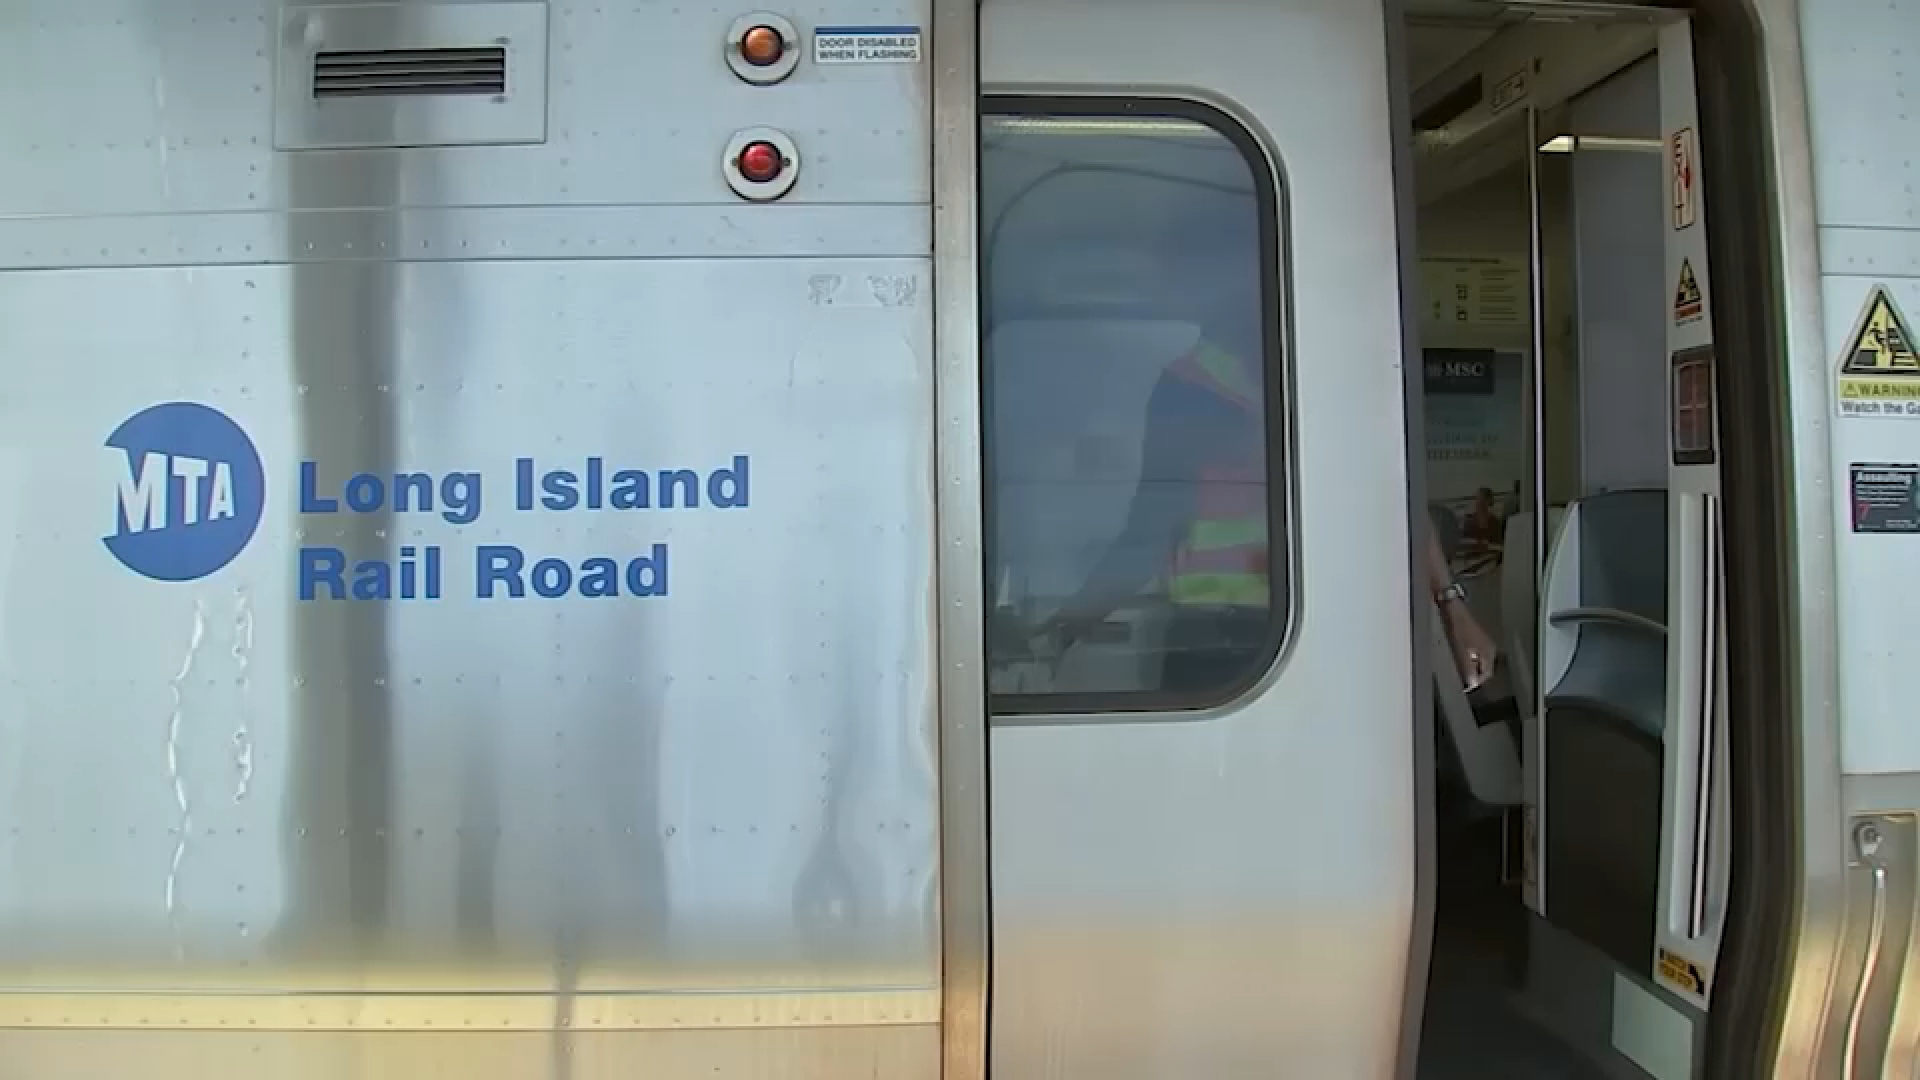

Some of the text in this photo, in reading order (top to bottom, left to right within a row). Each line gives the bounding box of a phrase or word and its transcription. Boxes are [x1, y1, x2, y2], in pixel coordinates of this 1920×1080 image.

[819, 37, 917, 48] DOOR DISABLED
[819, 49, 917, 60] WHEN FLASHING
[1445, 361, 1485, 377] MSC
[1841, 401, 1881, 413] Watch
[1883, 401, 1903, 415] the
[104, 444, 235, 538] MTA
[301, 456, 750, 524] Long Island
[301, 543, 669, 601] Rail Road
